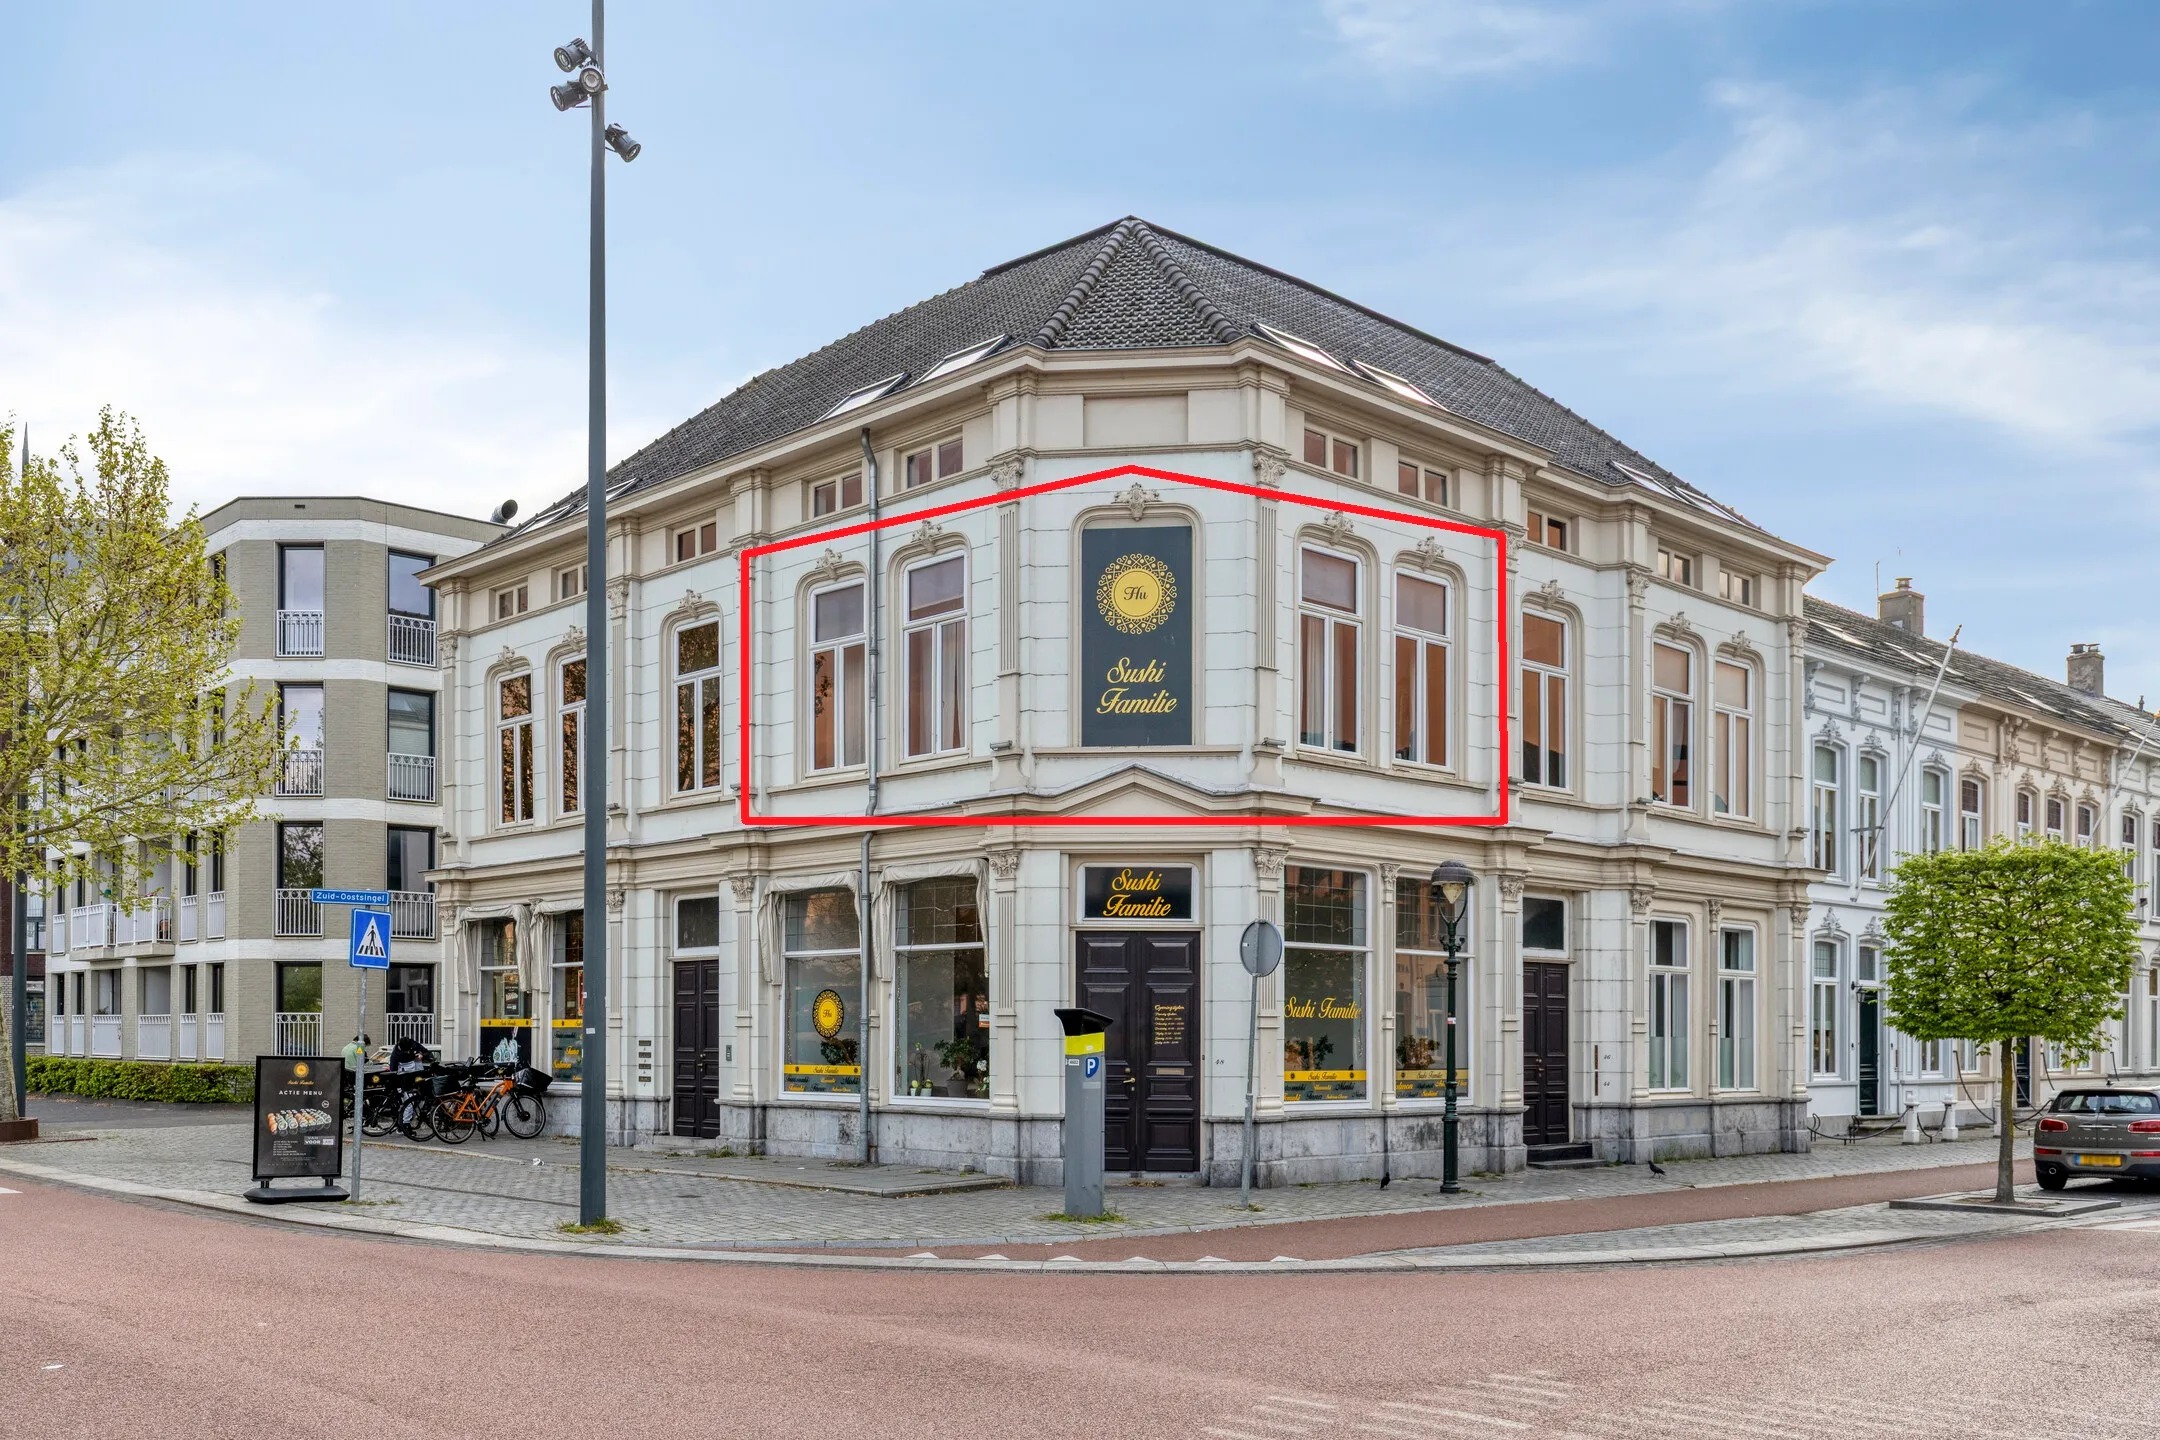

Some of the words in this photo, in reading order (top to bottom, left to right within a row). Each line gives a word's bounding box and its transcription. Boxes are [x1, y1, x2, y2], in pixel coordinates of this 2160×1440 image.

[1106, 656, 1167, 684] Sushi
[1095, 687, 1178, 715] Familie
[1111, 868, 1163, 891] Sushi
[316, 892, 385, 903] Zuid-Oostsingel
[1103, 893, 1172, 917] Familie
[1284, 996, 1317, 1018] Sushi
[1318, 997, 1362, 1019] Familie
[1087, 1058, 1096, 1074] P
